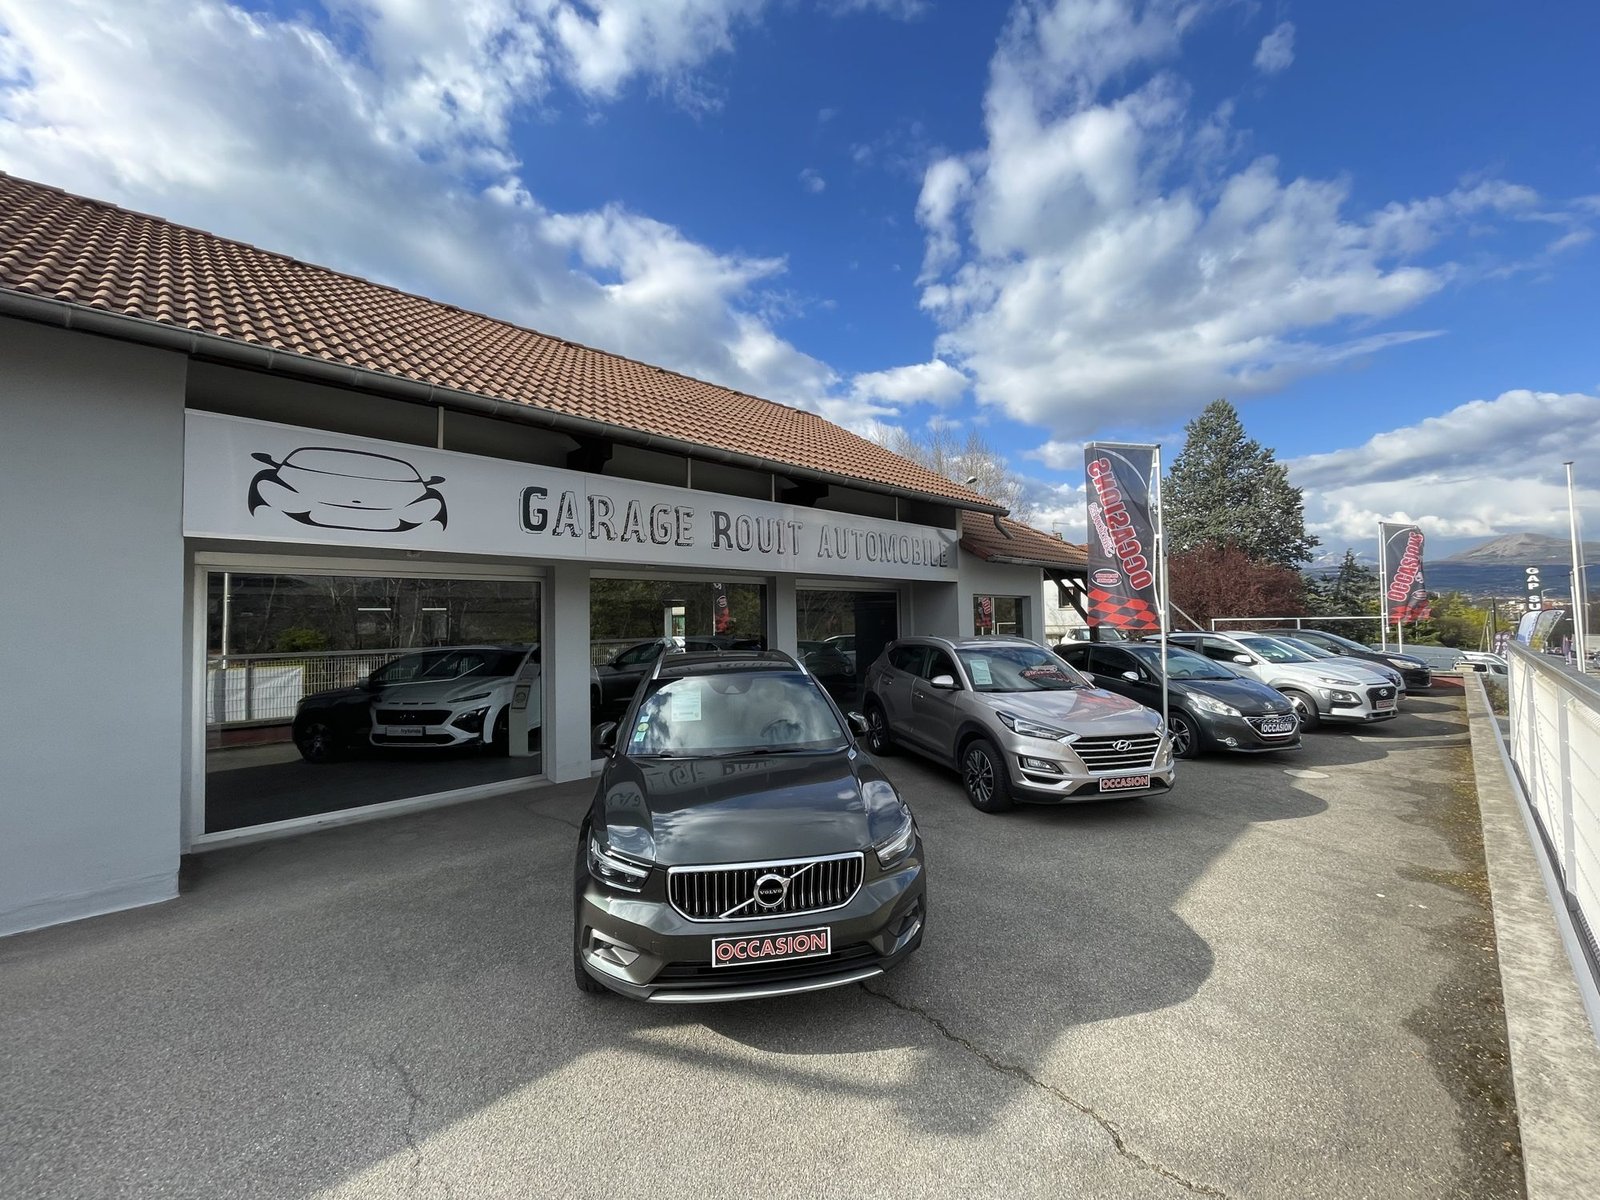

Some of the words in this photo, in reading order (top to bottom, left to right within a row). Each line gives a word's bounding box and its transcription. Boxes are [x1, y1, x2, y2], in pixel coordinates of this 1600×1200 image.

[519, 486, 695, 547] GARAGE
[710, 510, 803, 556] ROUIT
[817, 525, 949, 568] AUTOMOBILE
[1525, 567, 1540, 591] GAP
[1263, 722, 1292, 733] OCCASION
[1102, 776, 1148, 789] OCCASION
[716, 932, 826, 961] OCCASION
